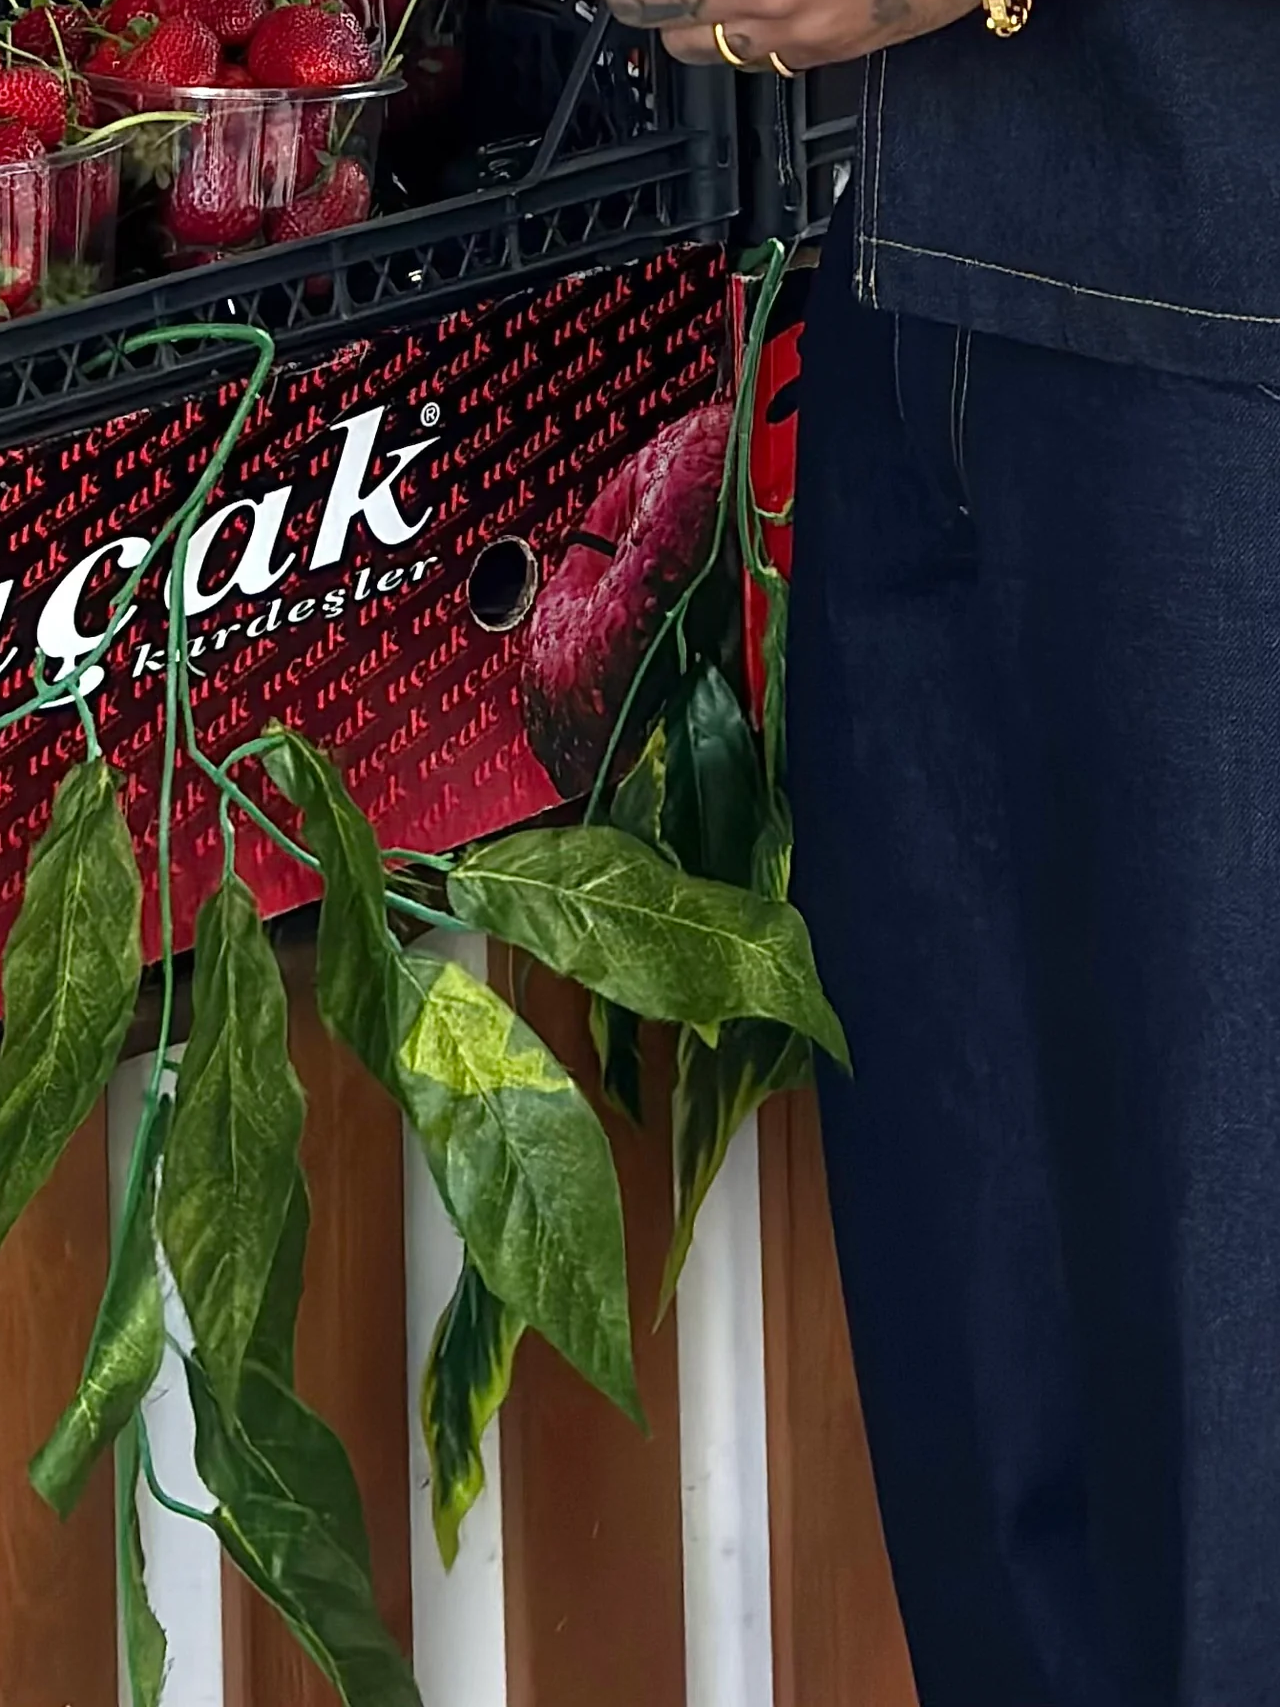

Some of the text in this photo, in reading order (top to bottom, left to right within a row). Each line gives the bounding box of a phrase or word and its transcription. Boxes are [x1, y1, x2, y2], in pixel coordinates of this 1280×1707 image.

[408, 330, 492, 406] uçak
[434, 271, 696, 480] uçak uçak uçak
[460, 340, 543, 415] uçak
[553, 274, 633, 347] uçak
[241, 403, 329, 481] uçak
[340, 334, 425, 410] uçak
[485, 413, 567, 489] uçak
[577, 346, 657, 420] uçak
[8, 470, 102, 551] uçak
[113, 398, 204, 477] uçak
[84, 465, 175, 545] uçak
[265, 619, 353, 700] uçak
[459, 477, 542, 554] uçak
[552, 409, 632, 484] uçak
[642, 342, 720, 415] uçak
[319, 627, 406, 708] uçak
[389, 621, 474, 701] uçak
[345, 701, 431, 783] uçak
[415, 695, 499, 775] uçak
